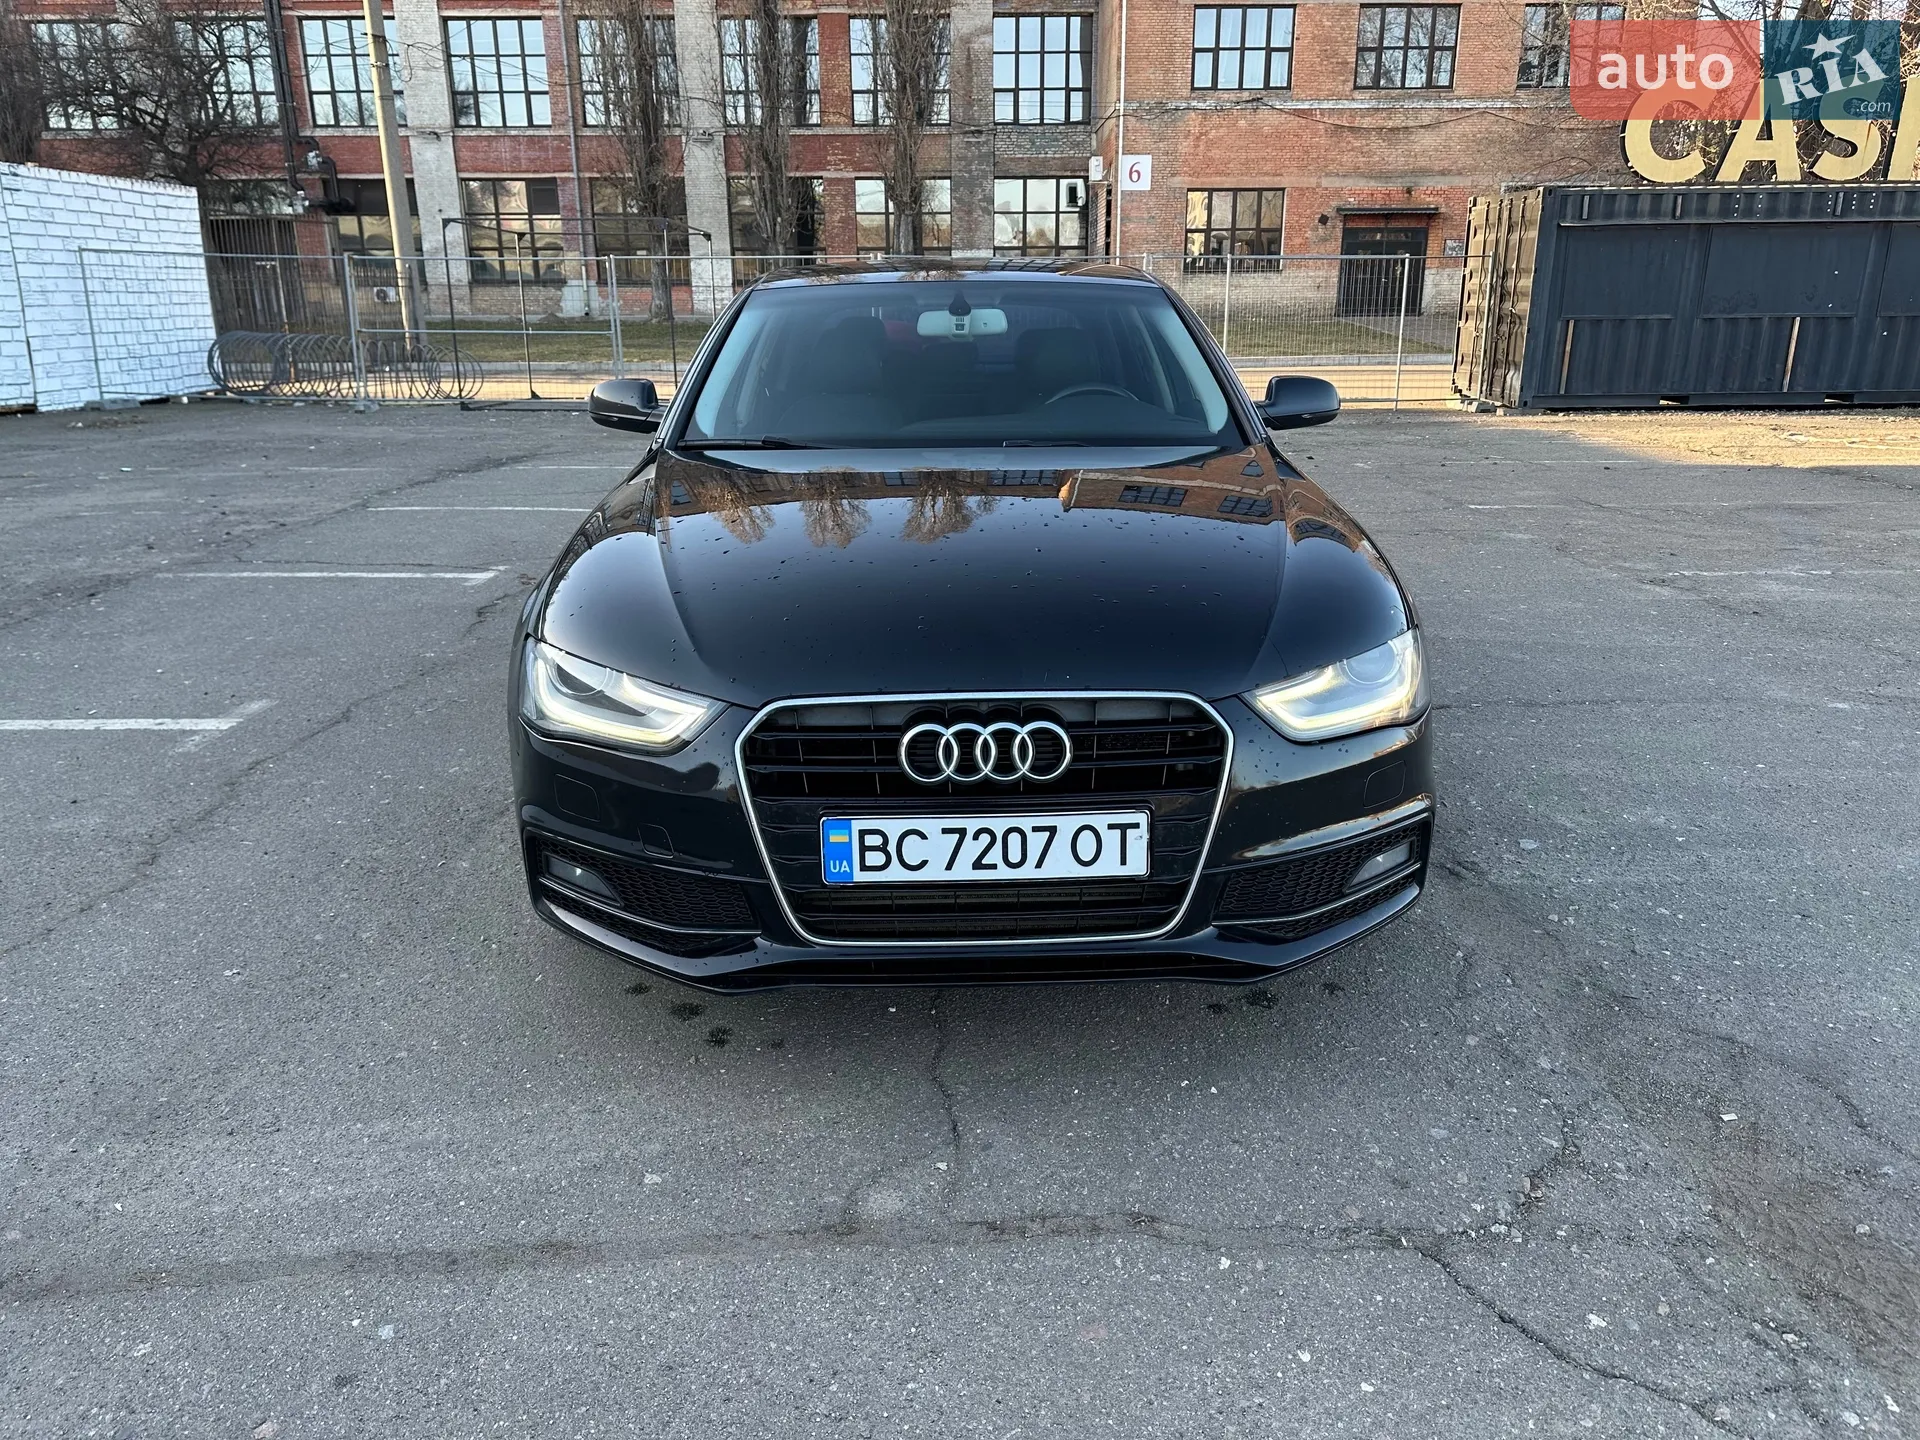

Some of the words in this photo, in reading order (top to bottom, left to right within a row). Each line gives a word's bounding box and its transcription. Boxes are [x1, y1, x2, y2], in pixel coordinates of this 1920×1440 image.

[1128, 161, 1141, 183] 6
[857, 828, 929, 873] BC
[940, 825, 1058, 871] 7207
[1070, 822, 1141, 867] OT
[830, 860, 851, 873] UA
